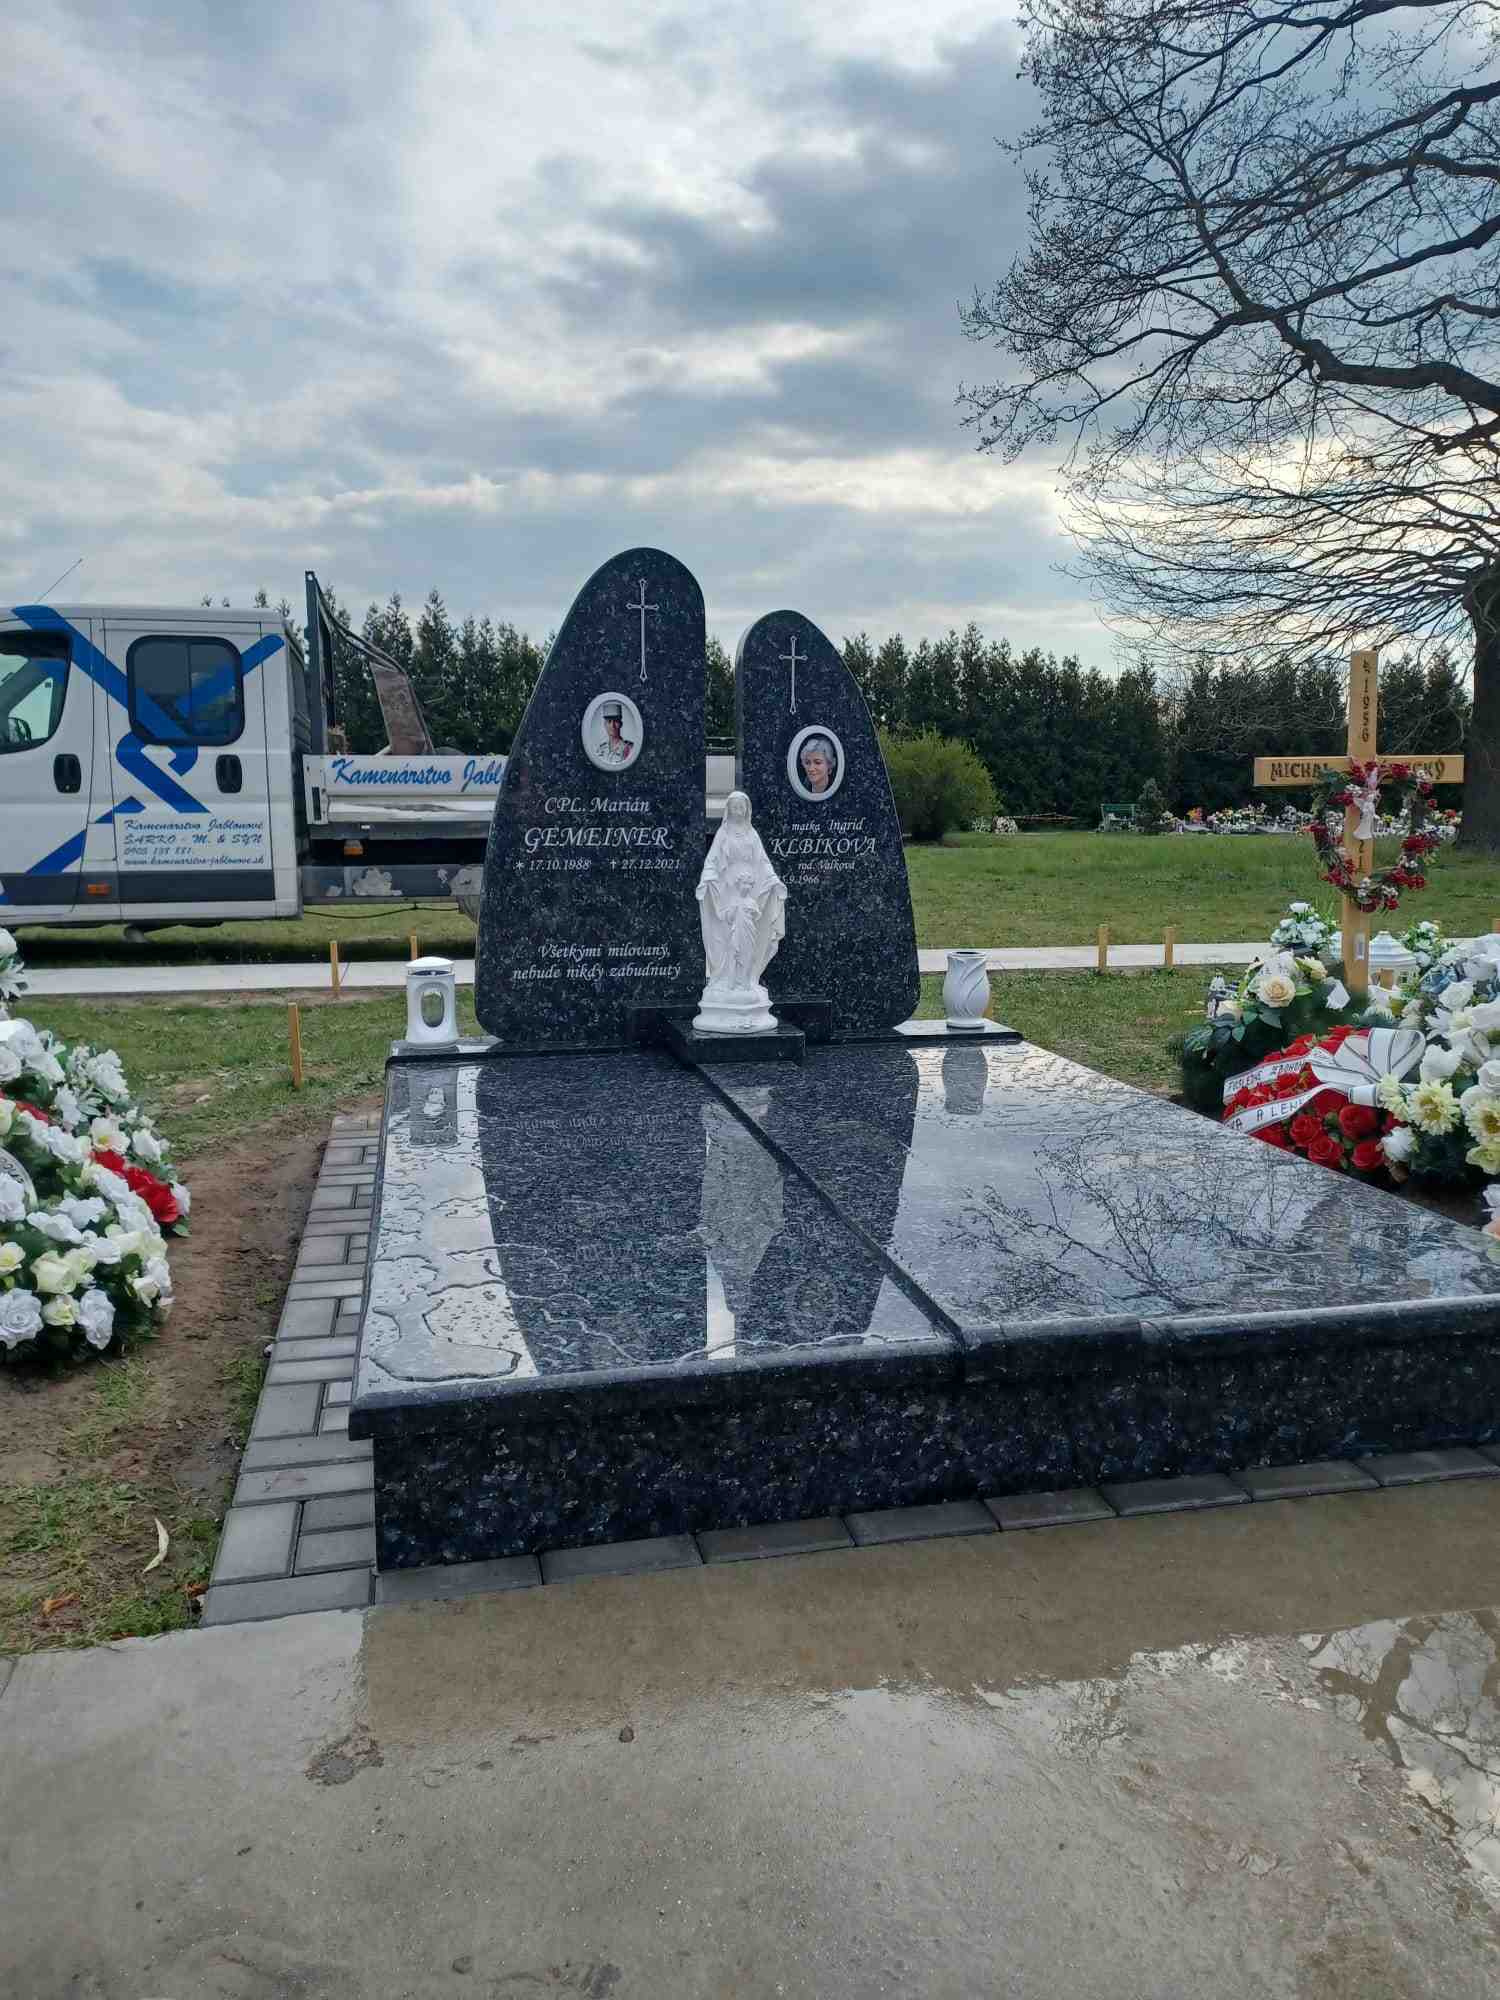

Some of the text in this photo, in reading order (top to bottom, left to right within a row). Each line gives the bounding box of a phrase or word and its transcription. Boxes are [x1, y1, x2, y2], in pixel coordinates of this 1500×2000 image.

[331, 757, 453, 785] Kamenárstvo
[1270, 761, 1328, 781] MICHA
[544, 796, 650, 814] CPL. Marián
[827, 815, 867, 834] Ingrid
[524, 826, 674, 853] GEMEINER
[528, 857, 682, 871] 17.10.1988 27.12.2021
[537, 942, 601, 963] Všetkými
[512, 961, 681, 981] nebude nikdy zabudnutý
